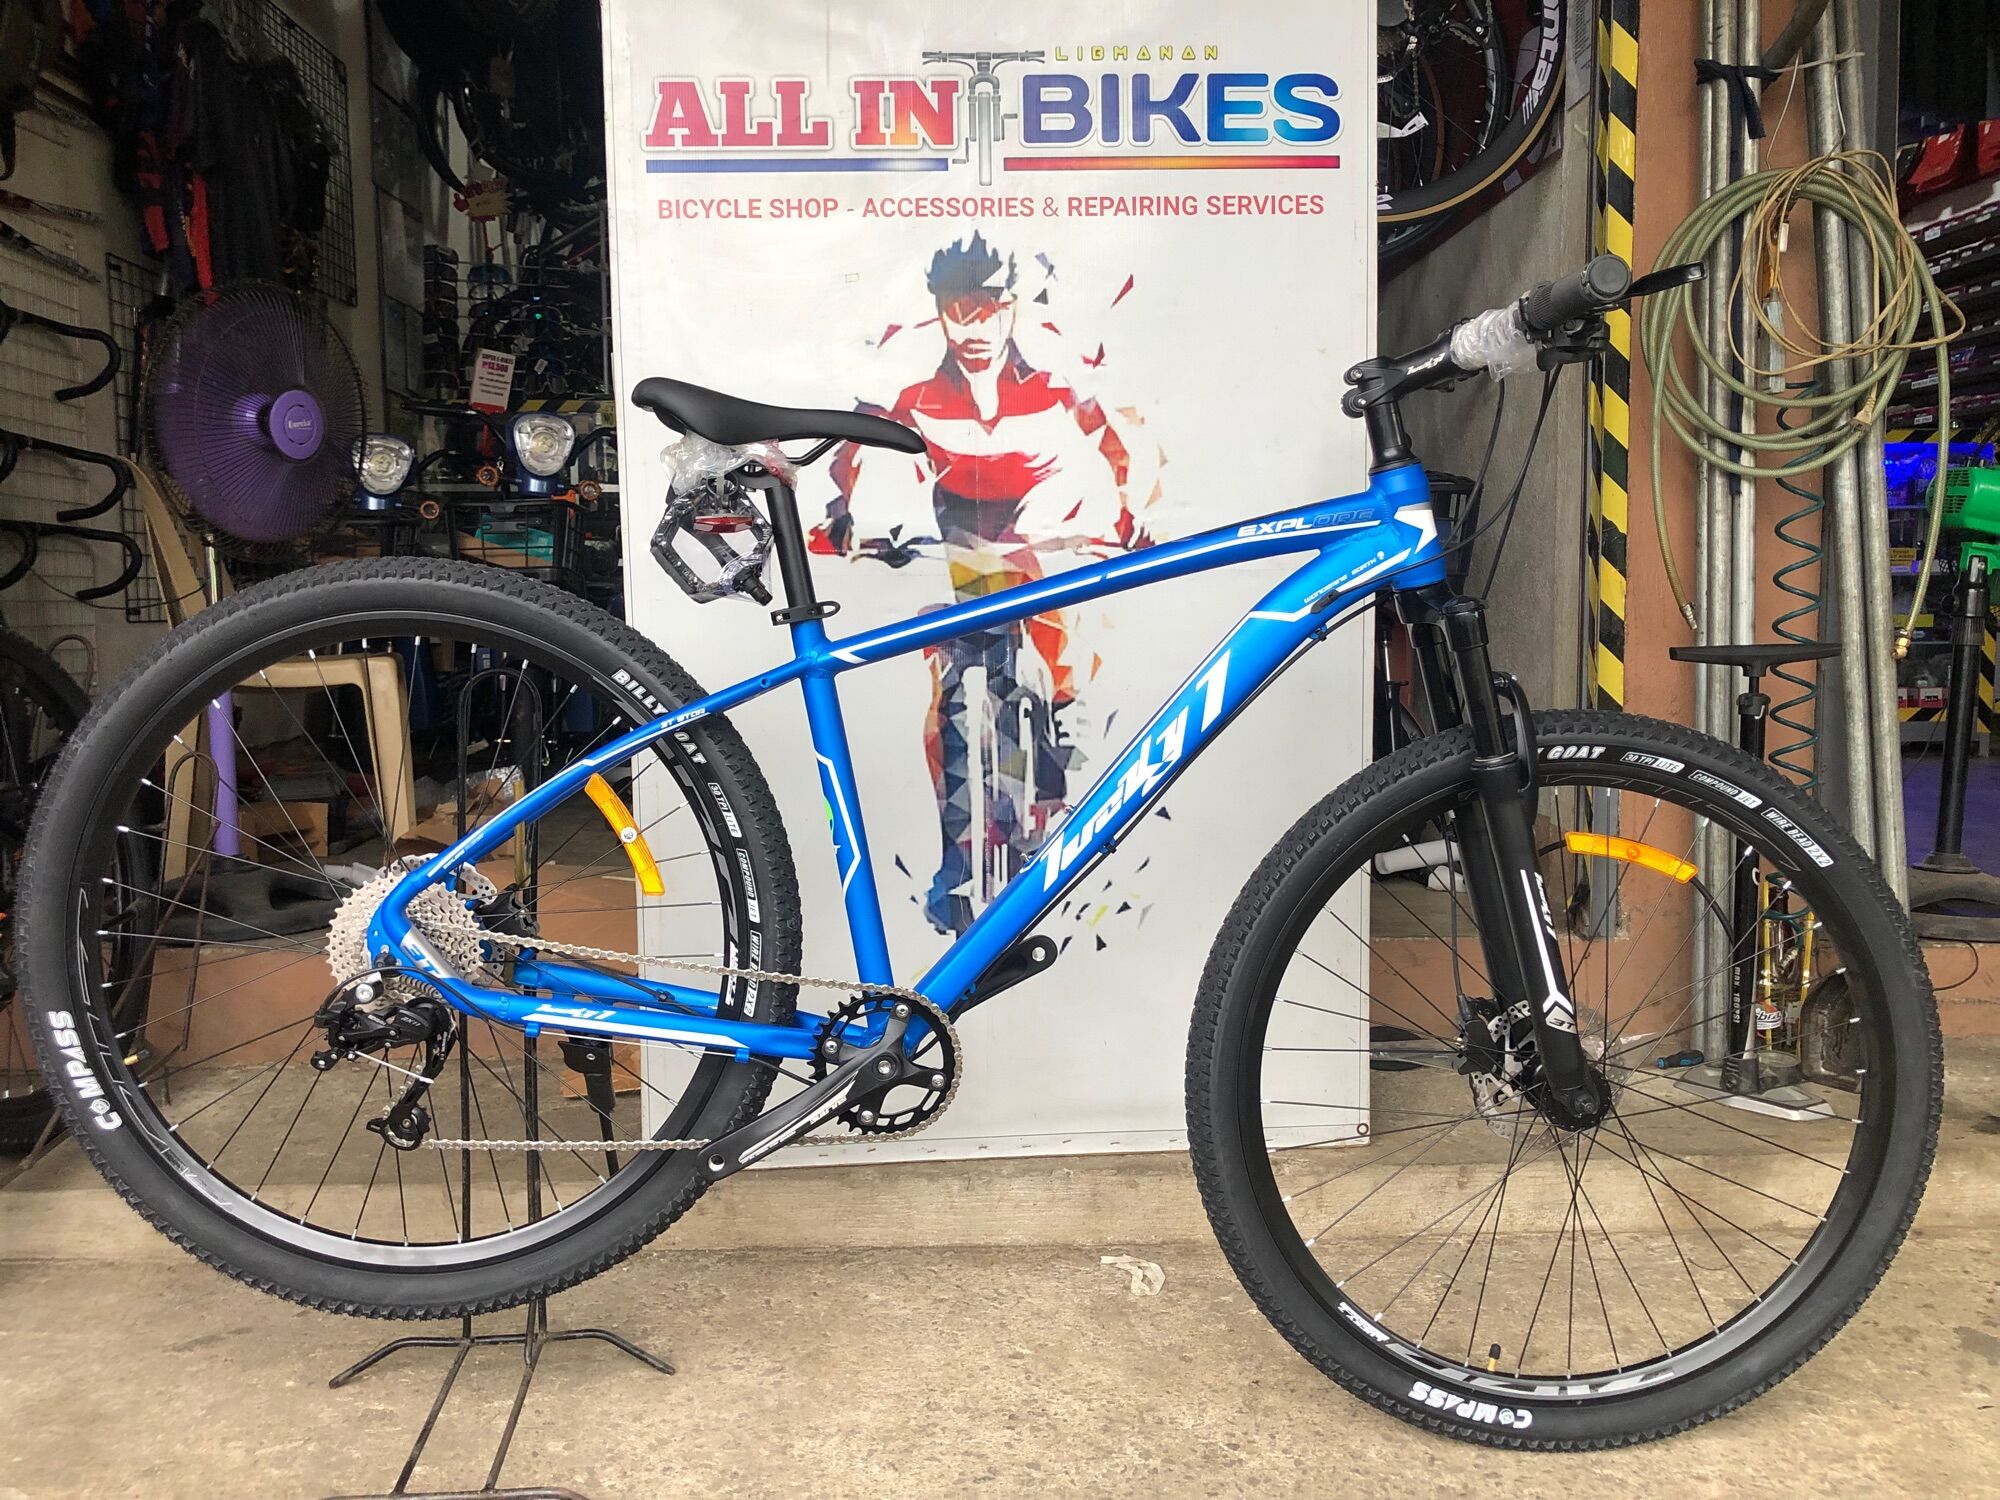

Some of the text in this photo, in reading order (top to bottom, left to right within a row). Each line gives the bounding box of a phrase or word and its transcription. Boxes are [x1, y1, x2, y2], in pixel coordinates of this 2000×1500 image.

[1055, 45, 1218, 61] LIBMANAN
[644, 72, 1342, 148] ALL IN BIKES
[657, 198, 762, 220] BICYCLE
[769, 198, 838, 219] SHOP
[861, 196, 1034, 219] ACCESSORIES
[1042, 197, 1059, 217] &
[1067, 194, 1198, 217] REPAIRING
[1206, 194, 1325, 215] SERVICES
[1237, 508, 1376, 538] EXPLORE
[611, 668, 708, 765] BILLY OAT
[1547, 745, 1606, 760] GOAT
[1625, 754, 1680, 773] 30 TPI LITE
[1693, 773, 1757, 807] COMPOUND JET
[710, 784, 739, 835] 30 TPI LITE
[1765, 810, 1792, 832] WIRE
[1787, 828, 1813, 849] BEAD
[738, 851, 758, 919] COMPOUND JET
[751, 934, 760, 962] WIRE
[48, 1010, 123, 1130] COMPASS
[1407, 1381, 1533, 1429] COMPASS
